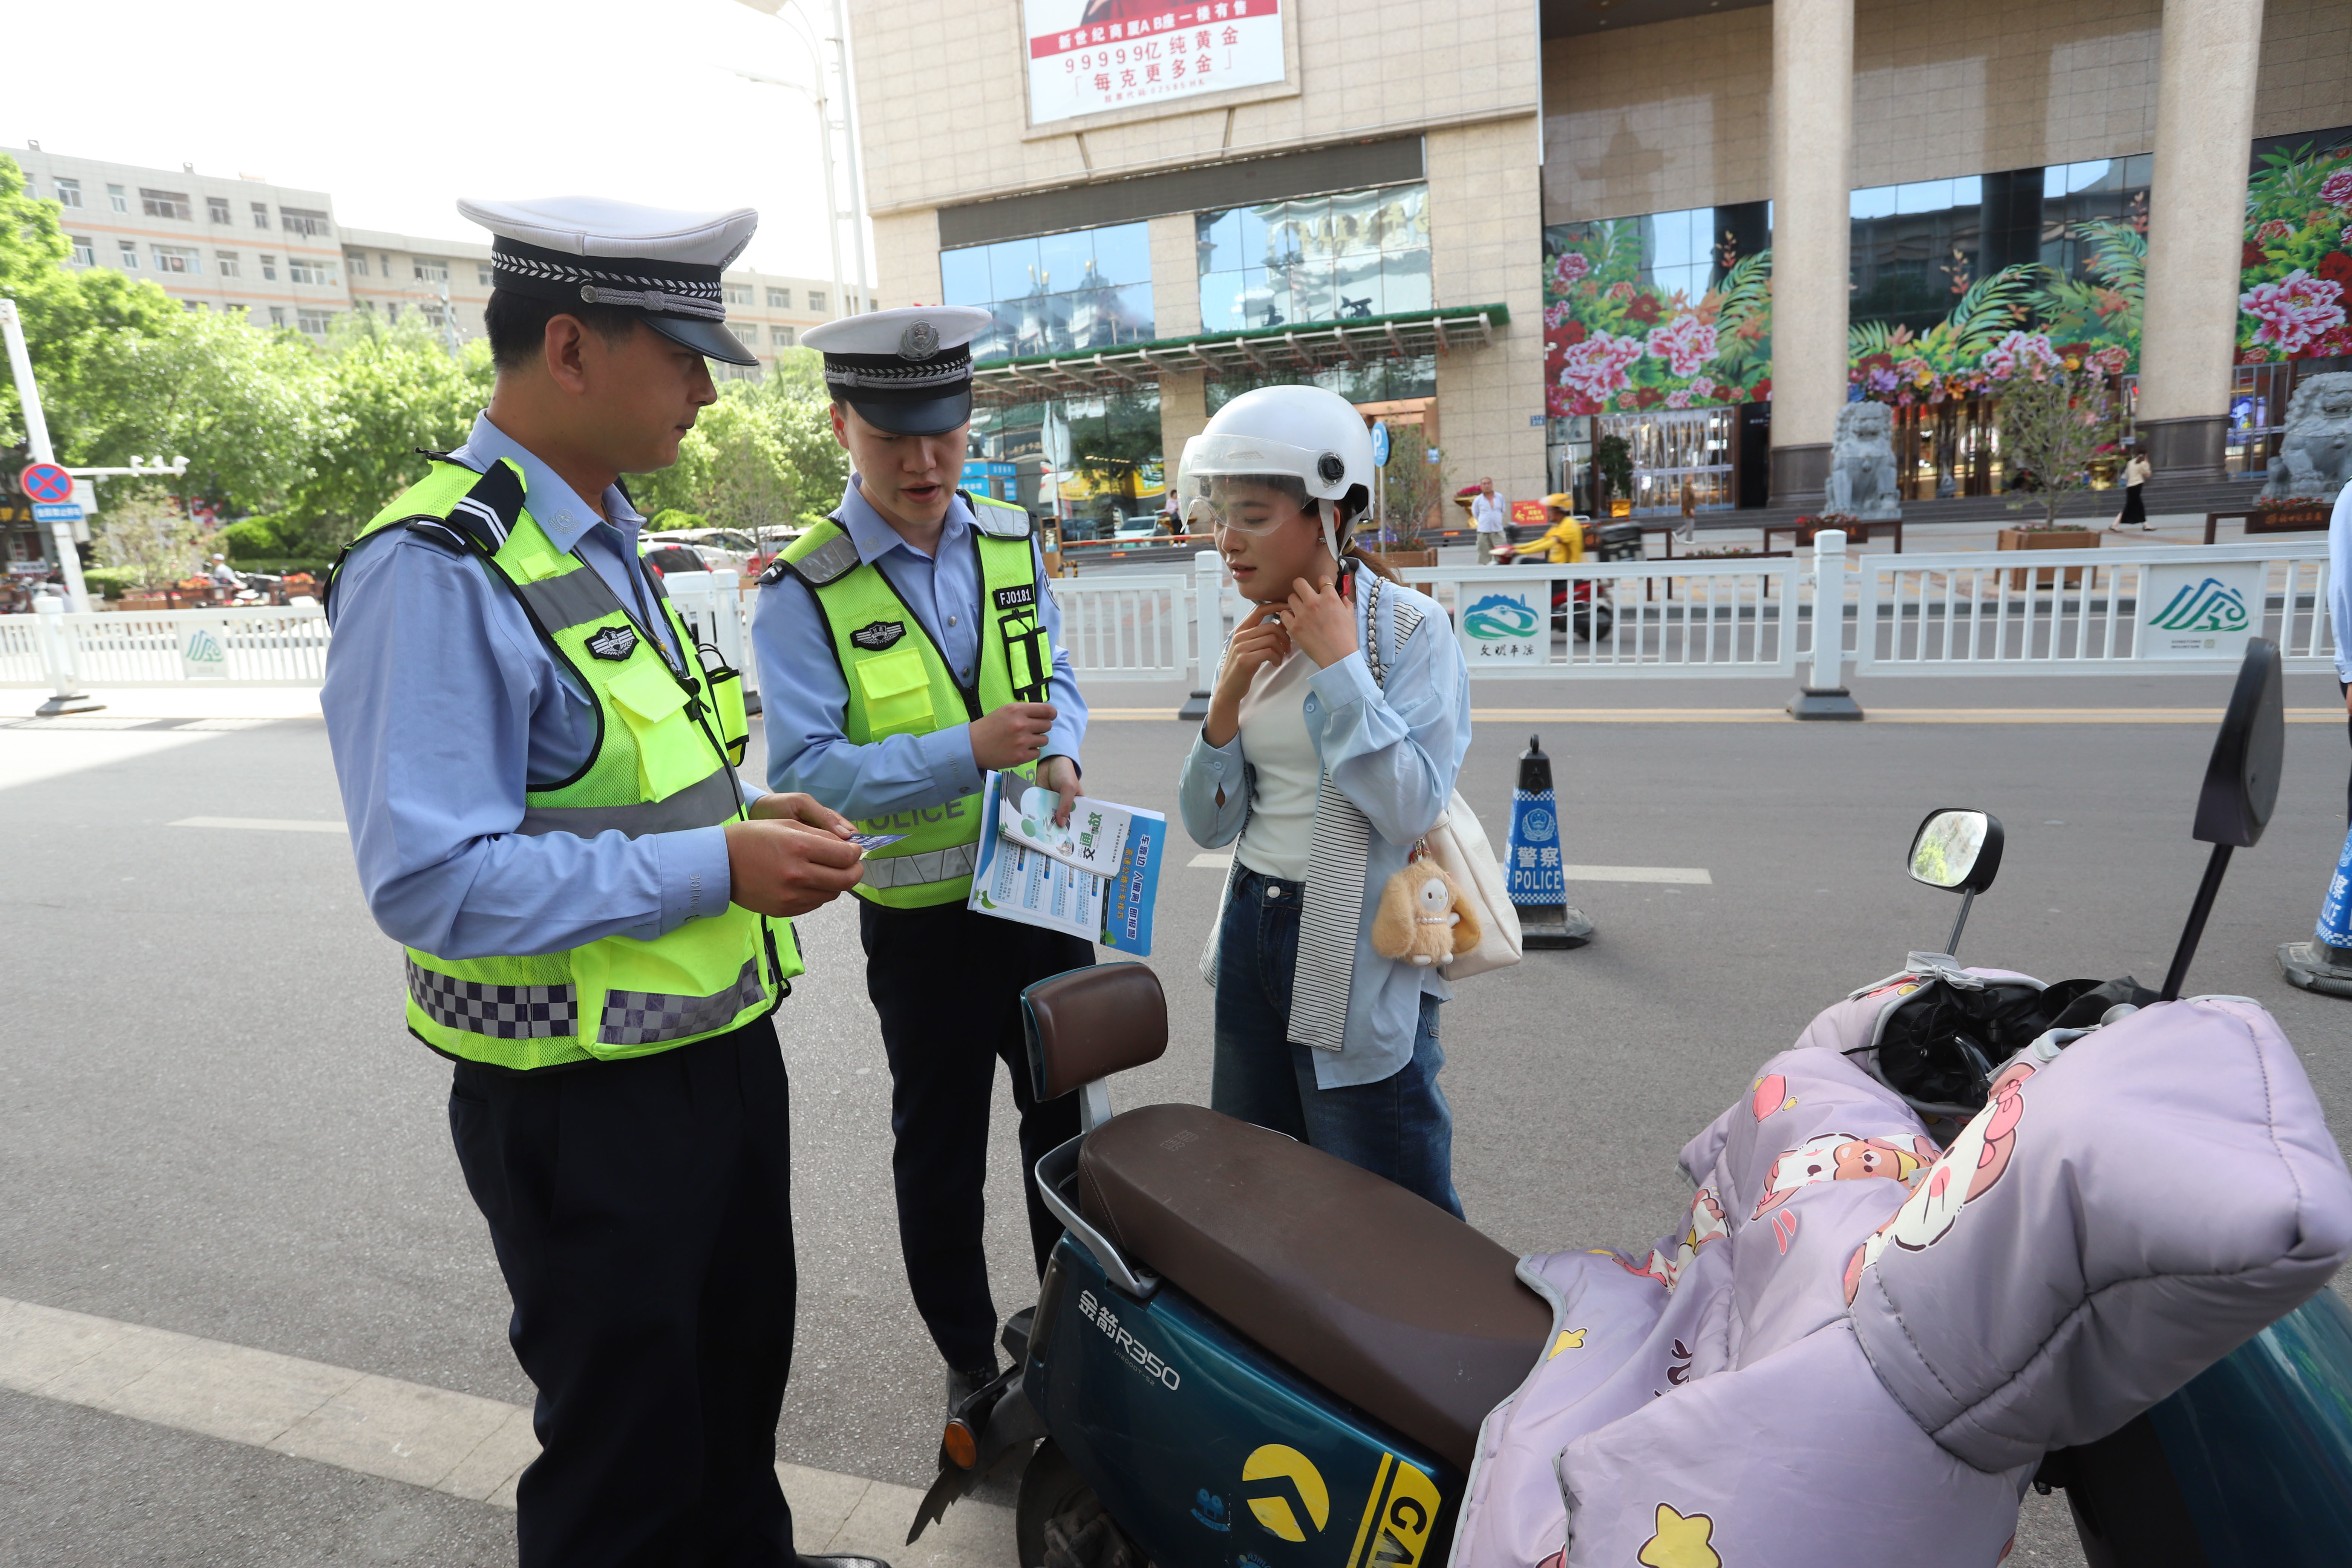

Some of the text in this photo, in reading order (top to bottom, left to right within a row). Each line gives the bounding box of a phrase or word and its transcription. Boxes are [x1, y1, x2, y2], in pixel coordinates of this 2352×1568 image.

[1066, 26, 1239, 74] 99999亿纯黄金
[1514, 870, 1561, 890] POLICE
[1517, 847, 1559, 868] 警察
[1116, 848, 1133, 920] 高速公路行车技巧
[1126, 834, 1150, 940] 车靠边 人撤离 即报警
